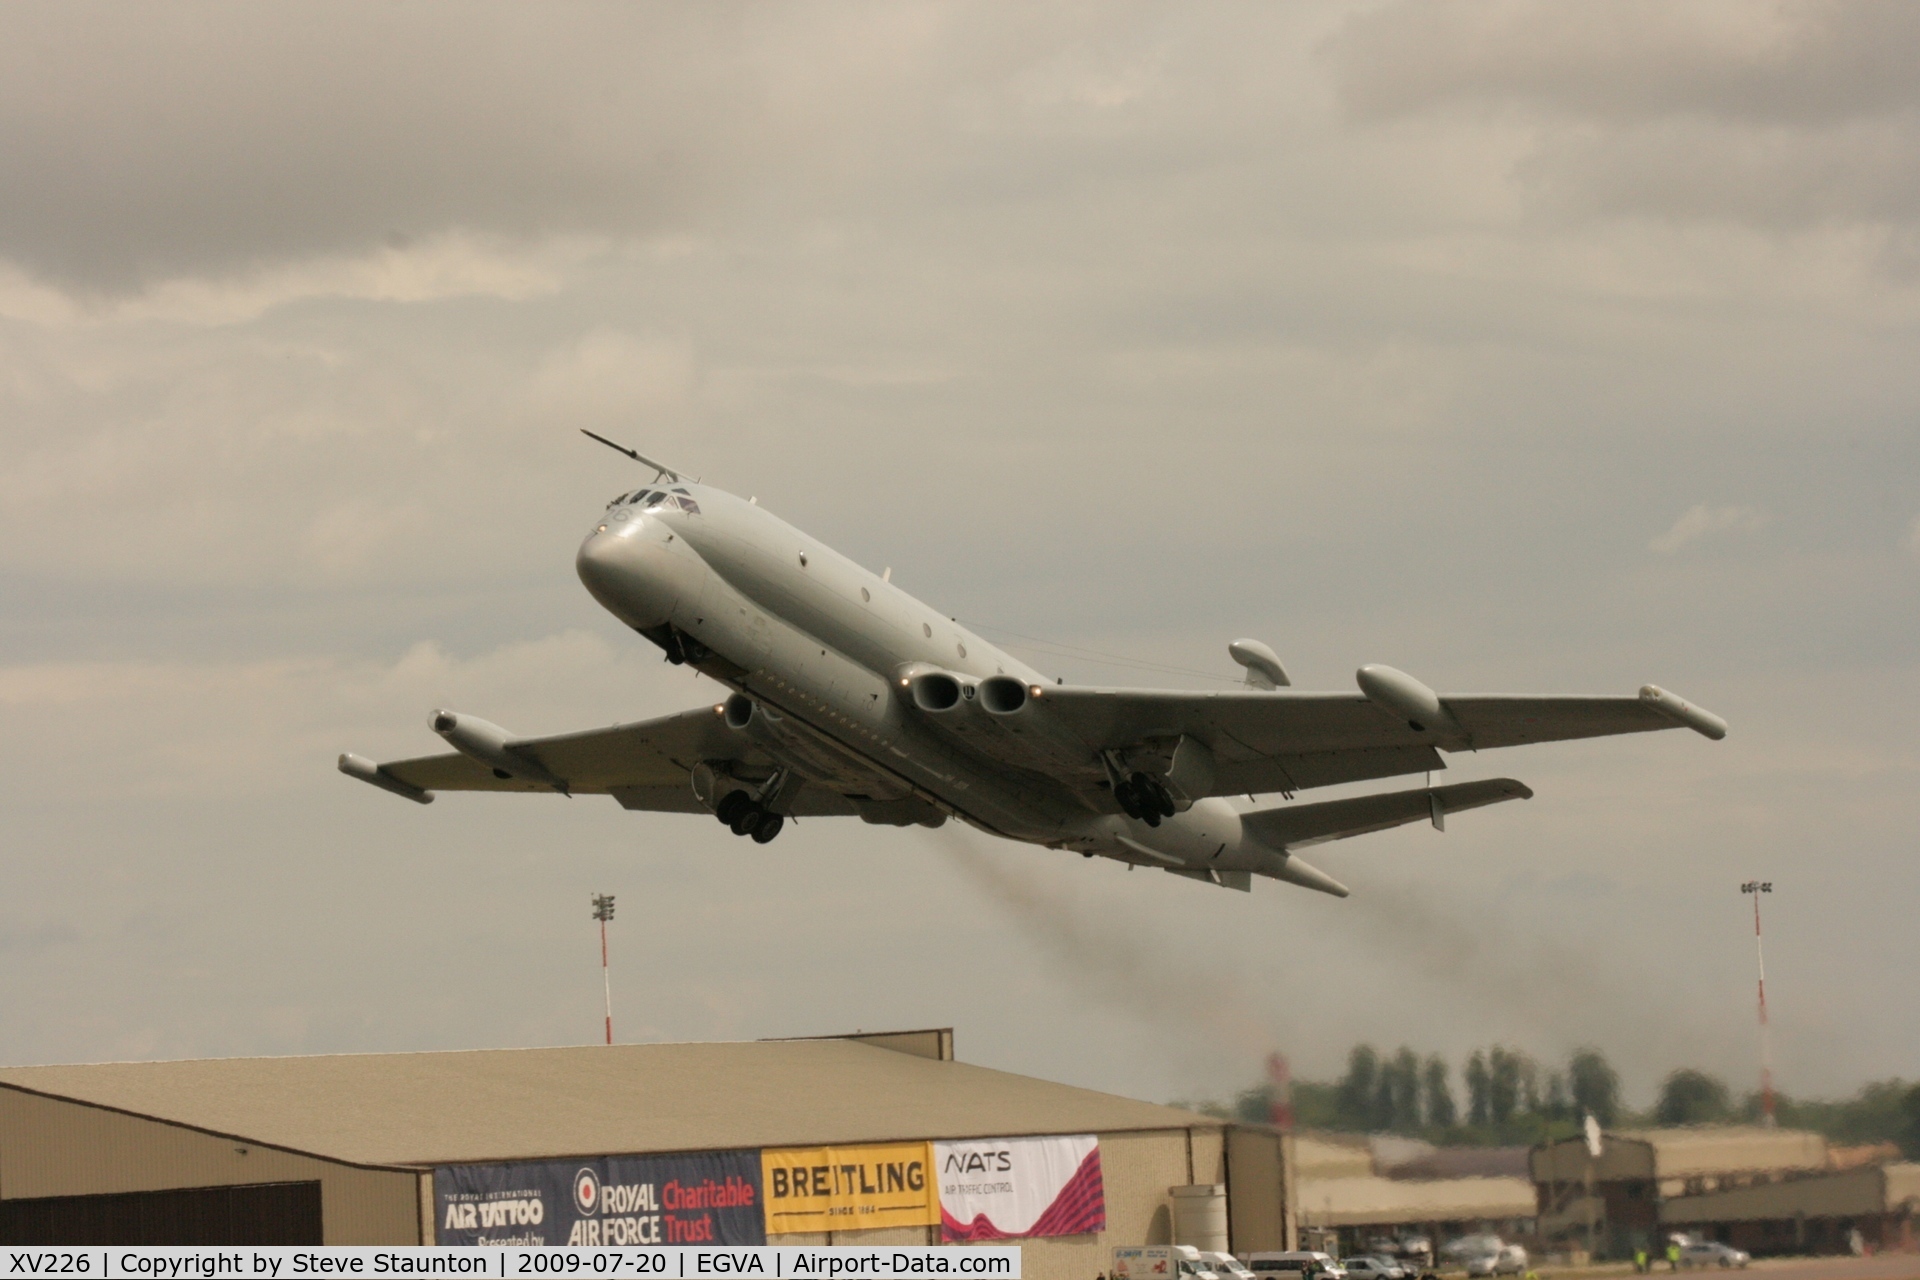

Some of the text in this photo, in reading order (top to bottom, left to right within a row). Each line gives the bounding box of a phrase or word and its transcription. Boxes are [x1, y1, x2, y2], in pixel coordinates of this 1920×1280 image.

[945, 1151, 1011, 1174] NATS
[772, 1162, 924, 1198] BREITLING
[945, 1182, 1014, 1195] AIR TRAFFIC CONTROL
[445, 1190, 542, 1202] THE ROYAL INTERNATIONAL
[602, 1177, 753, 1214] ROYAL Charitable
[445, 1199, 544, 1229] AIR TATTOO
[829, 1206, 854, 1216] SINCE
[567, 1214, 712, 1246] AIR FORCE Trust
